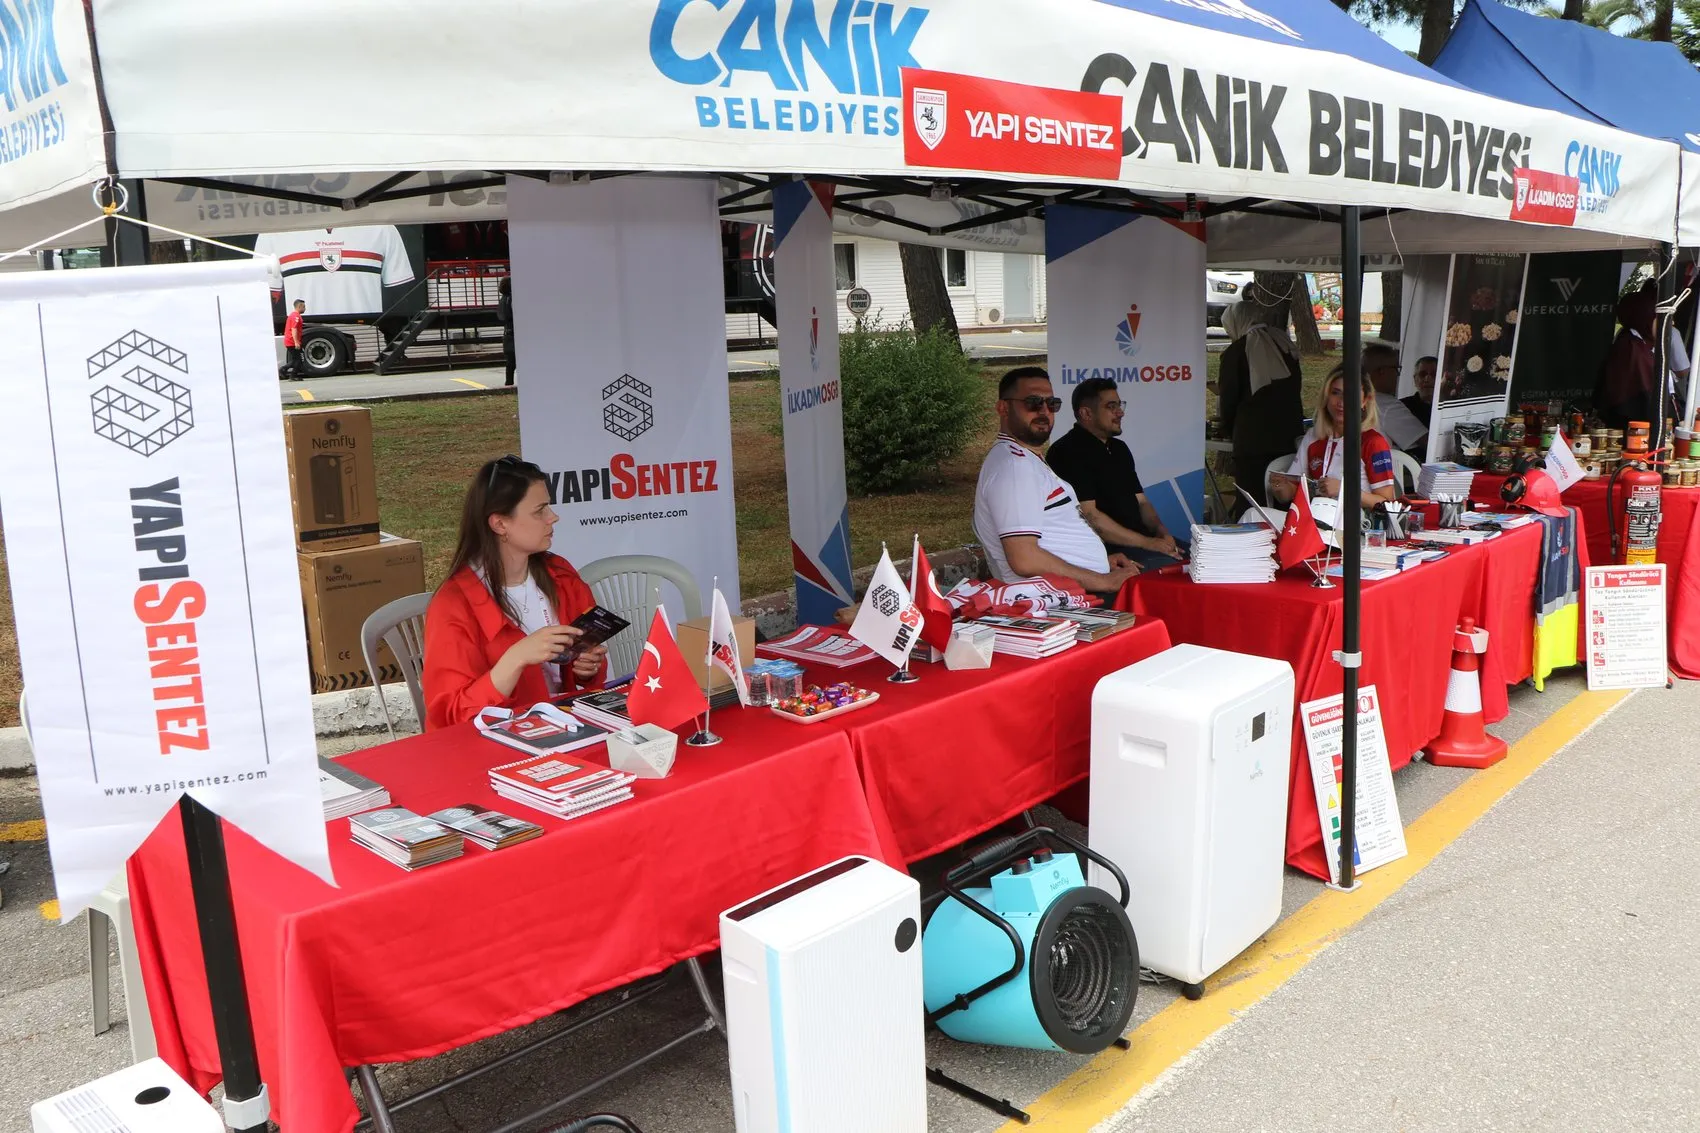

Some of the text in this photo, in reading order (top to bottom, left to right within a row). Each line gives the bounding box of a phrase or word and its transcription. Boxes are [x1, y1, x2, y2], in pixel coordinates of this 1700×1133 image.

[695, 95, 900, 137] BELEDİYES
[965, 109, 1114, 150] YAPI SENTEZ
[1555, 191, 1577, 210] OSGB
[312, 435, 356, 449] Nemfly
[545, 453, 719, 505] YAPISENTEZ
[579, 507, 688, 527] www.yapisentez.com
[129, 476, 211, 755] YAPISENTEZ
[104, 769, 268, 797] www.yapisentez.com
